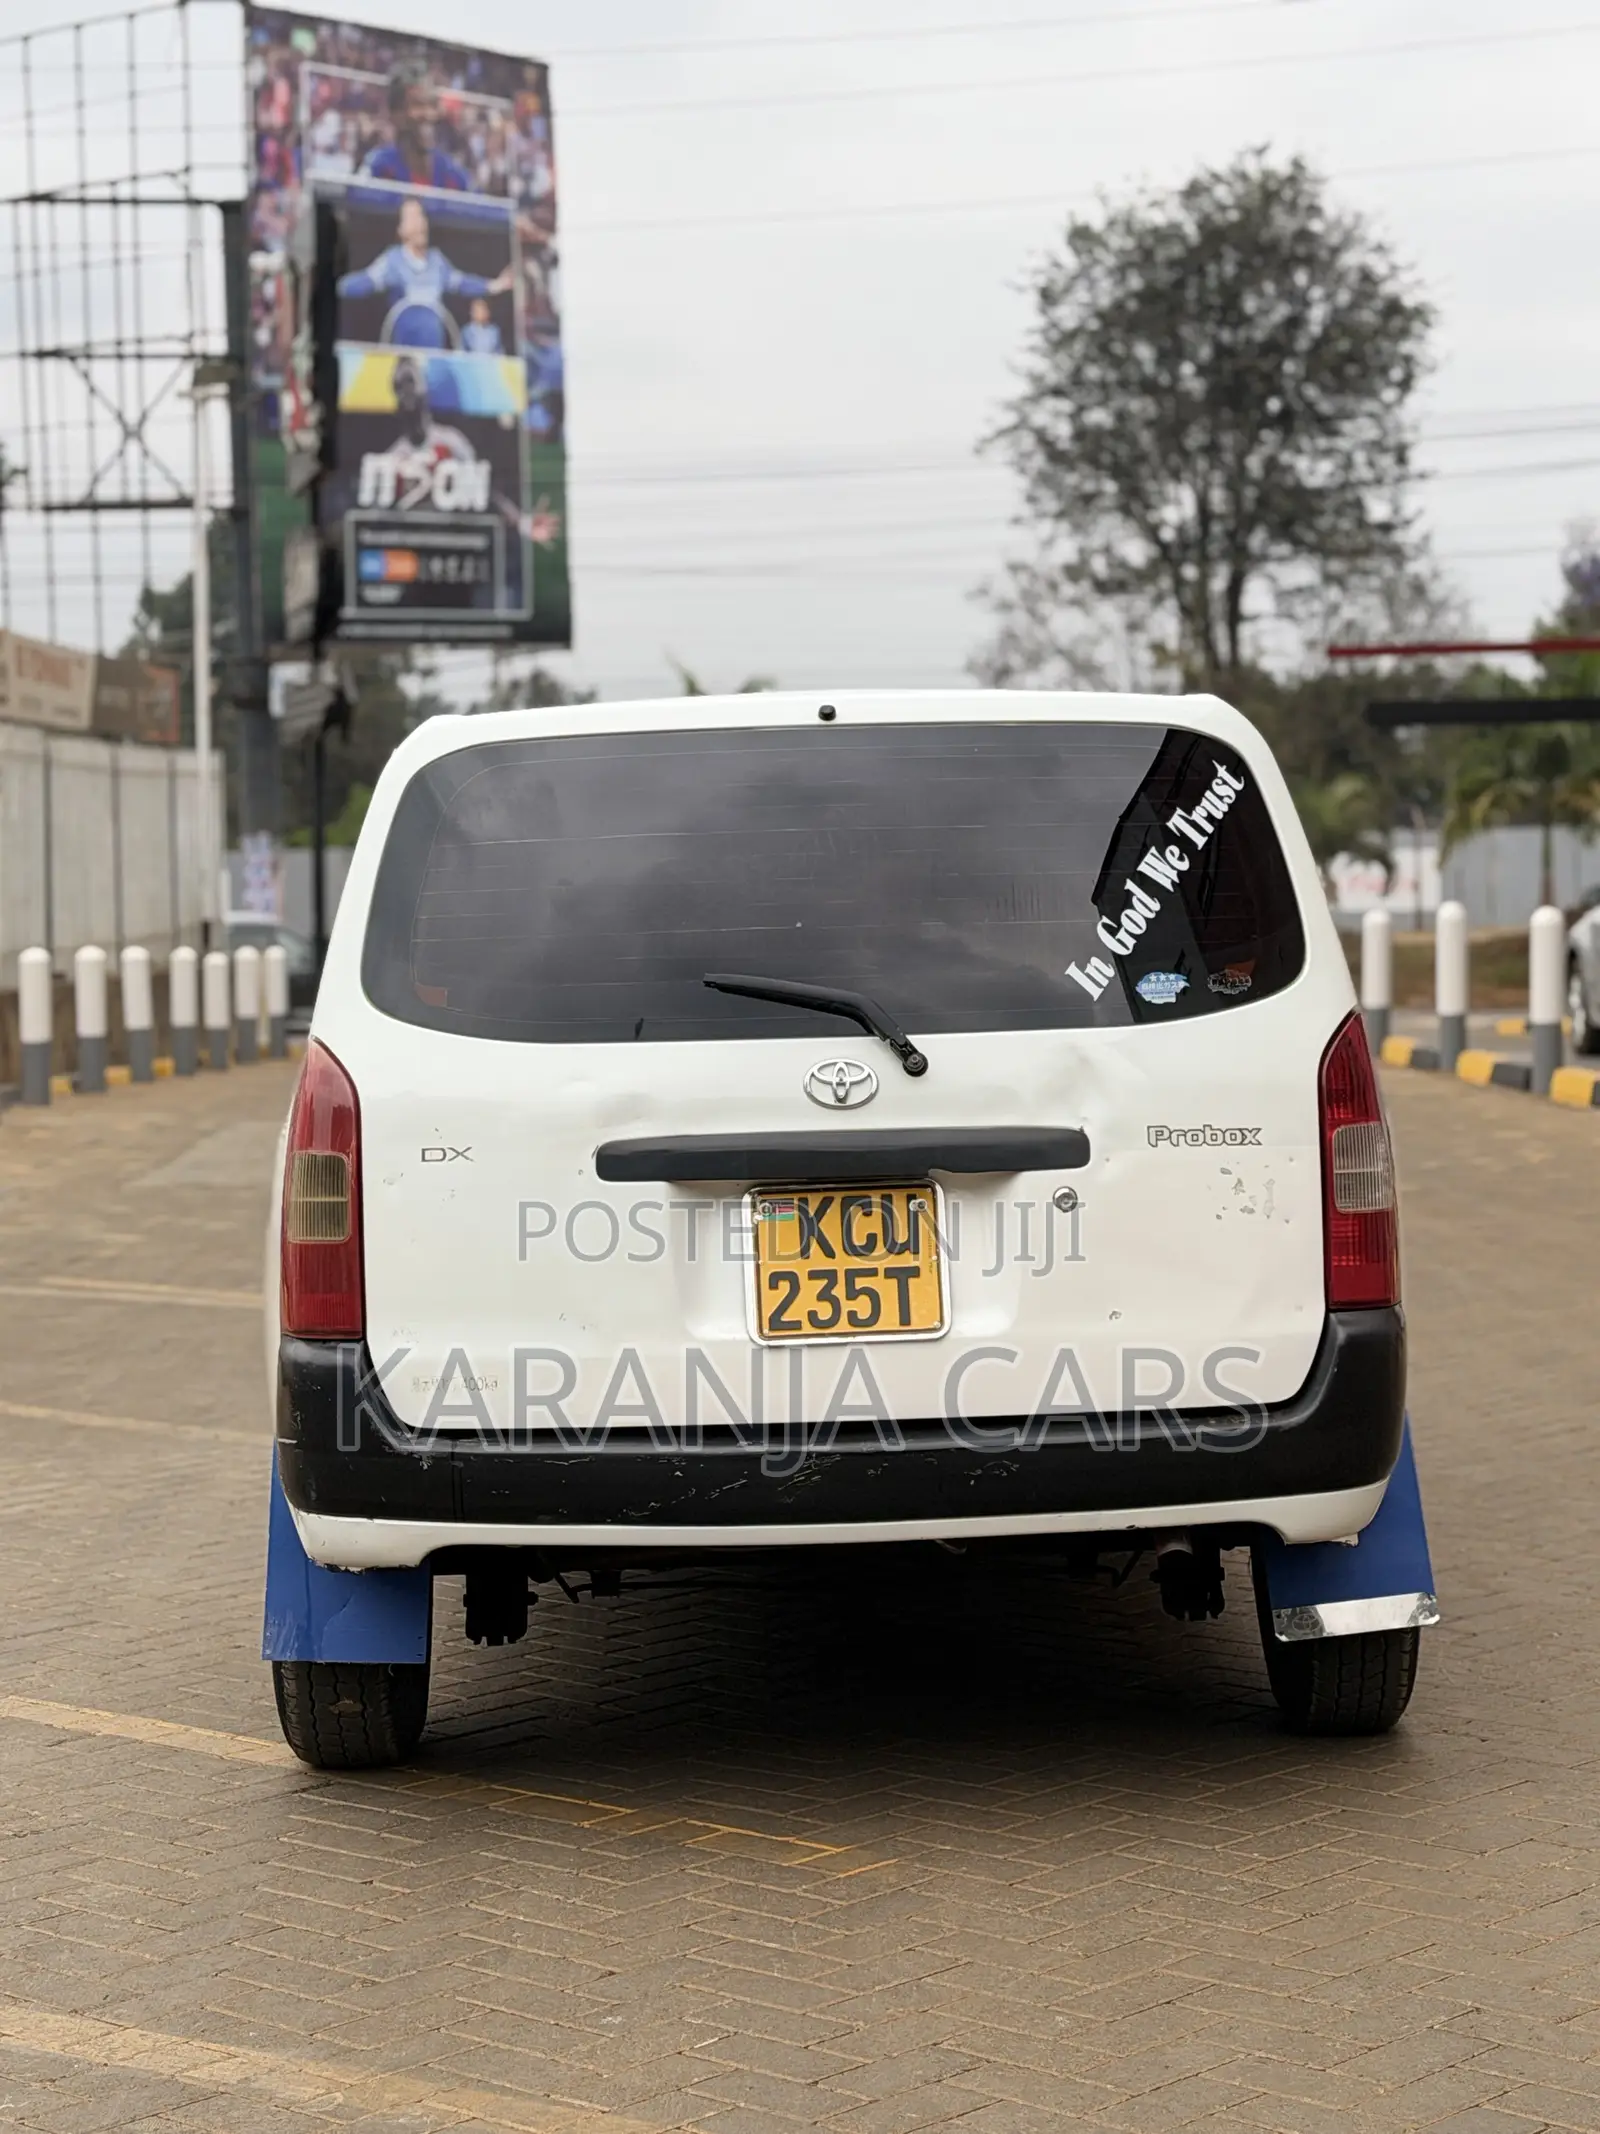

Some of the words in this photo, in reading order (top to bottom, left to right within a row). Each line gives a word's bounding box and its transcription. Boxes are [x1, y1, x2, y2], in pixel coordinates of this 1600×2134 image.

[1064, 956, 1116, 1001] In
[1096, 878, 1161, 956] God
[1136, 845, 1190, 893] We
[1165, 759, 1245, 850] Trust
[421, 1146, 474, 1162] DX
[1147, 1124, 1263, 1147] Probox
[798, 1193, 920, 1259] KCU
[768, 1266, 920, 1331] 235T
